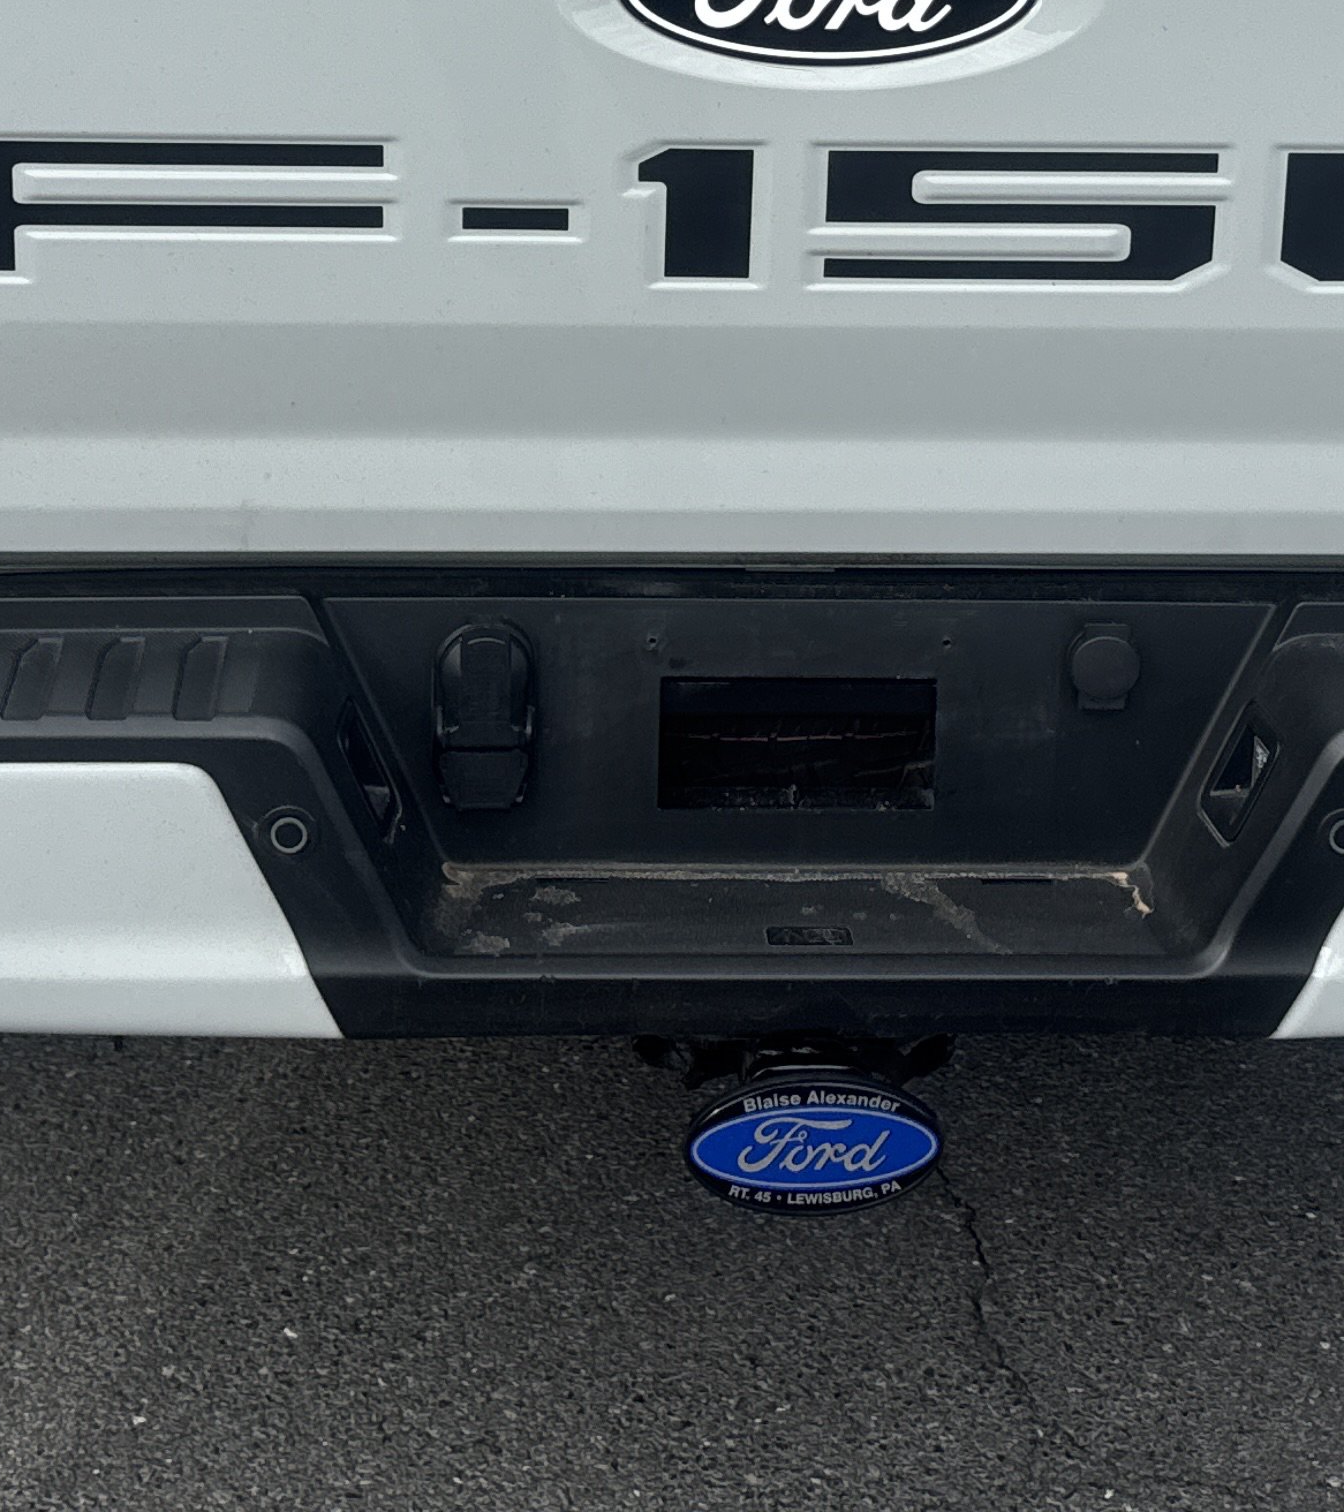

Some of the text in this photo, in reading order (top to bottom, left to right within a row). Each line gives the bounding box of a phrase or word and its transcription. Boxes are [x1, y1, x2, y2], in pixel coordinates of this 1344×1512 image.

[743, 1090, 901, 1113] Blaise Alexander
[737, 1116, 891, 1173] Ford
[728, 1180, 902, 1205] RT. 45 LEWISBURG, PA
